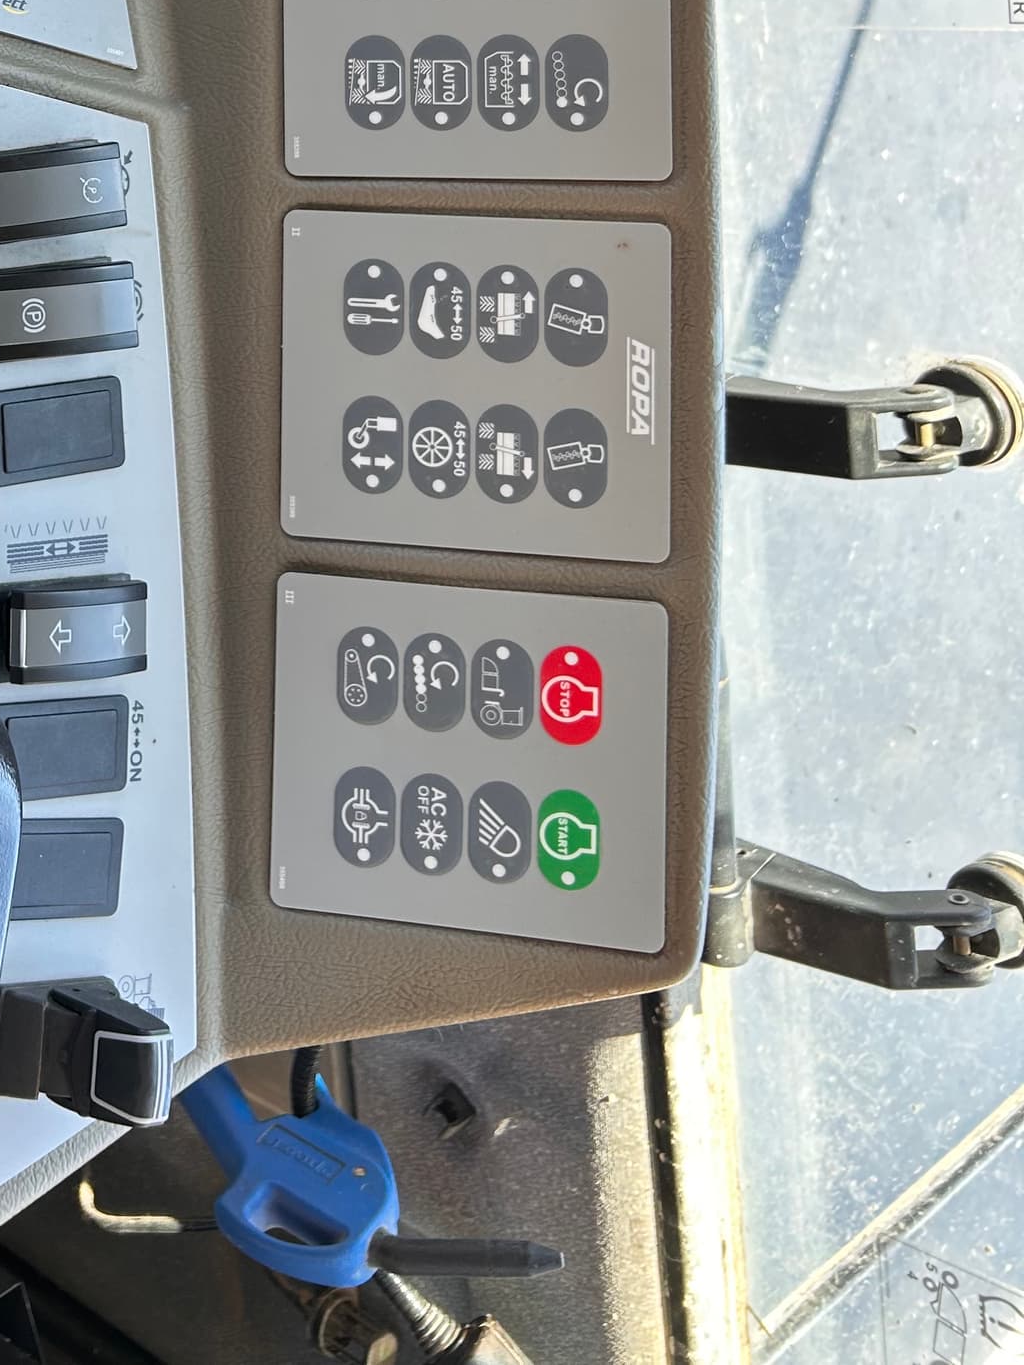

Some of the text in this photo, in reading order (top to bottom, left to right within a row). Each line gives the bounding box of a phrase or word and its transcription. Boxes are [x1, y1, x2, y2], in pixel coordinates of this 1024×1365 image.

[1013, 2, 1024, 15] R
[376, 62, 385, 90] man.
[442, 63, 455, 102] AUTO
[489, 66, 497, 94] man.
[450, 286, 463, 341] 45 50
[630, 338, 652, 437] ROPA
[453, 421, 466, 477] 45 50
[559, 681, 571, 717] STOP
[129, 700, 146, 783] 45 ON
[417, 785, 429, 815] OFF
[431, 786, 447, 817] AC
[557, 816, 569, 855] START
[906, 1270, 919, 1281] 4
[925, 1261, 938, 1274] 5
